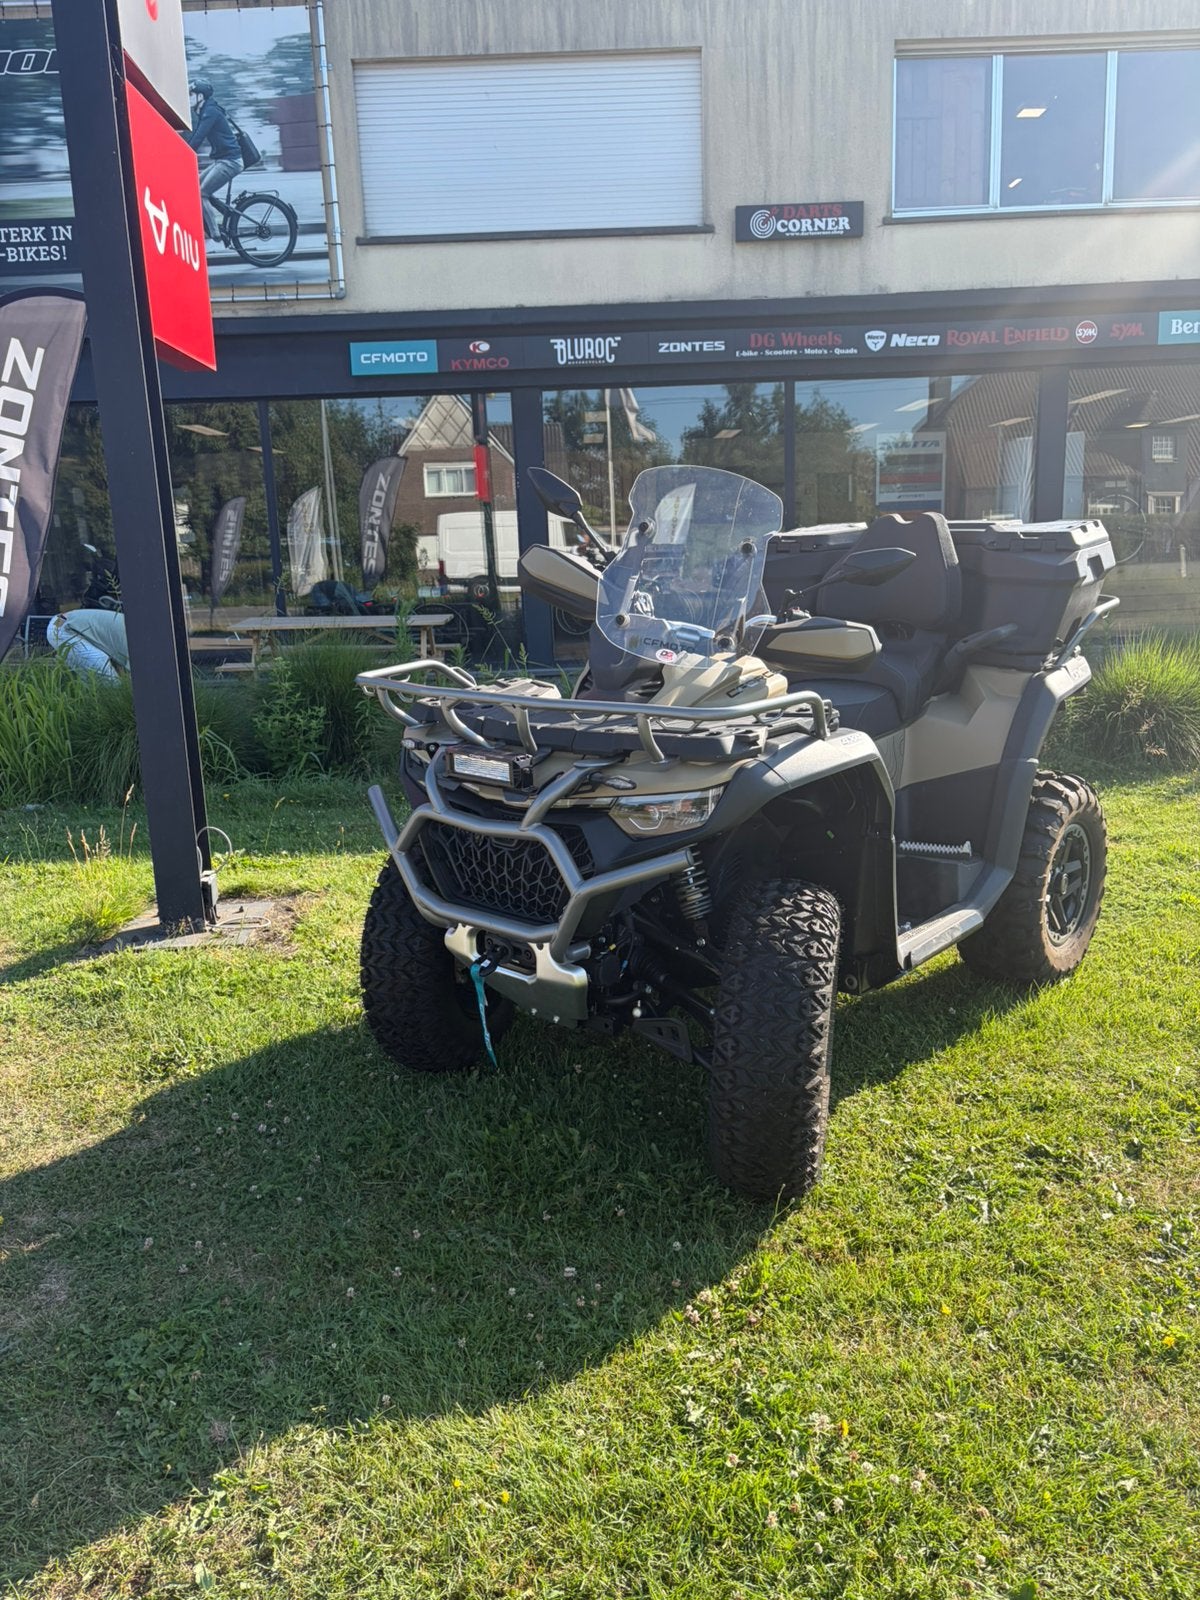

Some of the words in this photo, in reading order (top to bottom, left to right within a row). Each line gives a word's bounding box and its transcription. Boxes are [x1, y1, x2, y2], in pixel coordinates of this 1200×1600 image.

[783, 203, 842, 219] DARTS
[776, 216, 851, 233] CORNER
[50, 225, 73, 241] IN
[173, 221, 200, 272] niu
[750, 332, 776, 348] DG
[781, 331, 843, 347] Wheels
[890, 333, 940, 347] Neco
[946, 329, 1000, 346] ROYAL
[1003, 326, 1070, 345] ENFIELD
[1077, 328, 1097, 338] SYM
[1110, 323, 1145, 341] SYM
[549, 336, 622, 365] BLUROC
[658, 340, 726, 353] ZONTES
[360, 351, 429, 364] CFMOTO
[451, 357, 510, 370] KYMCO
